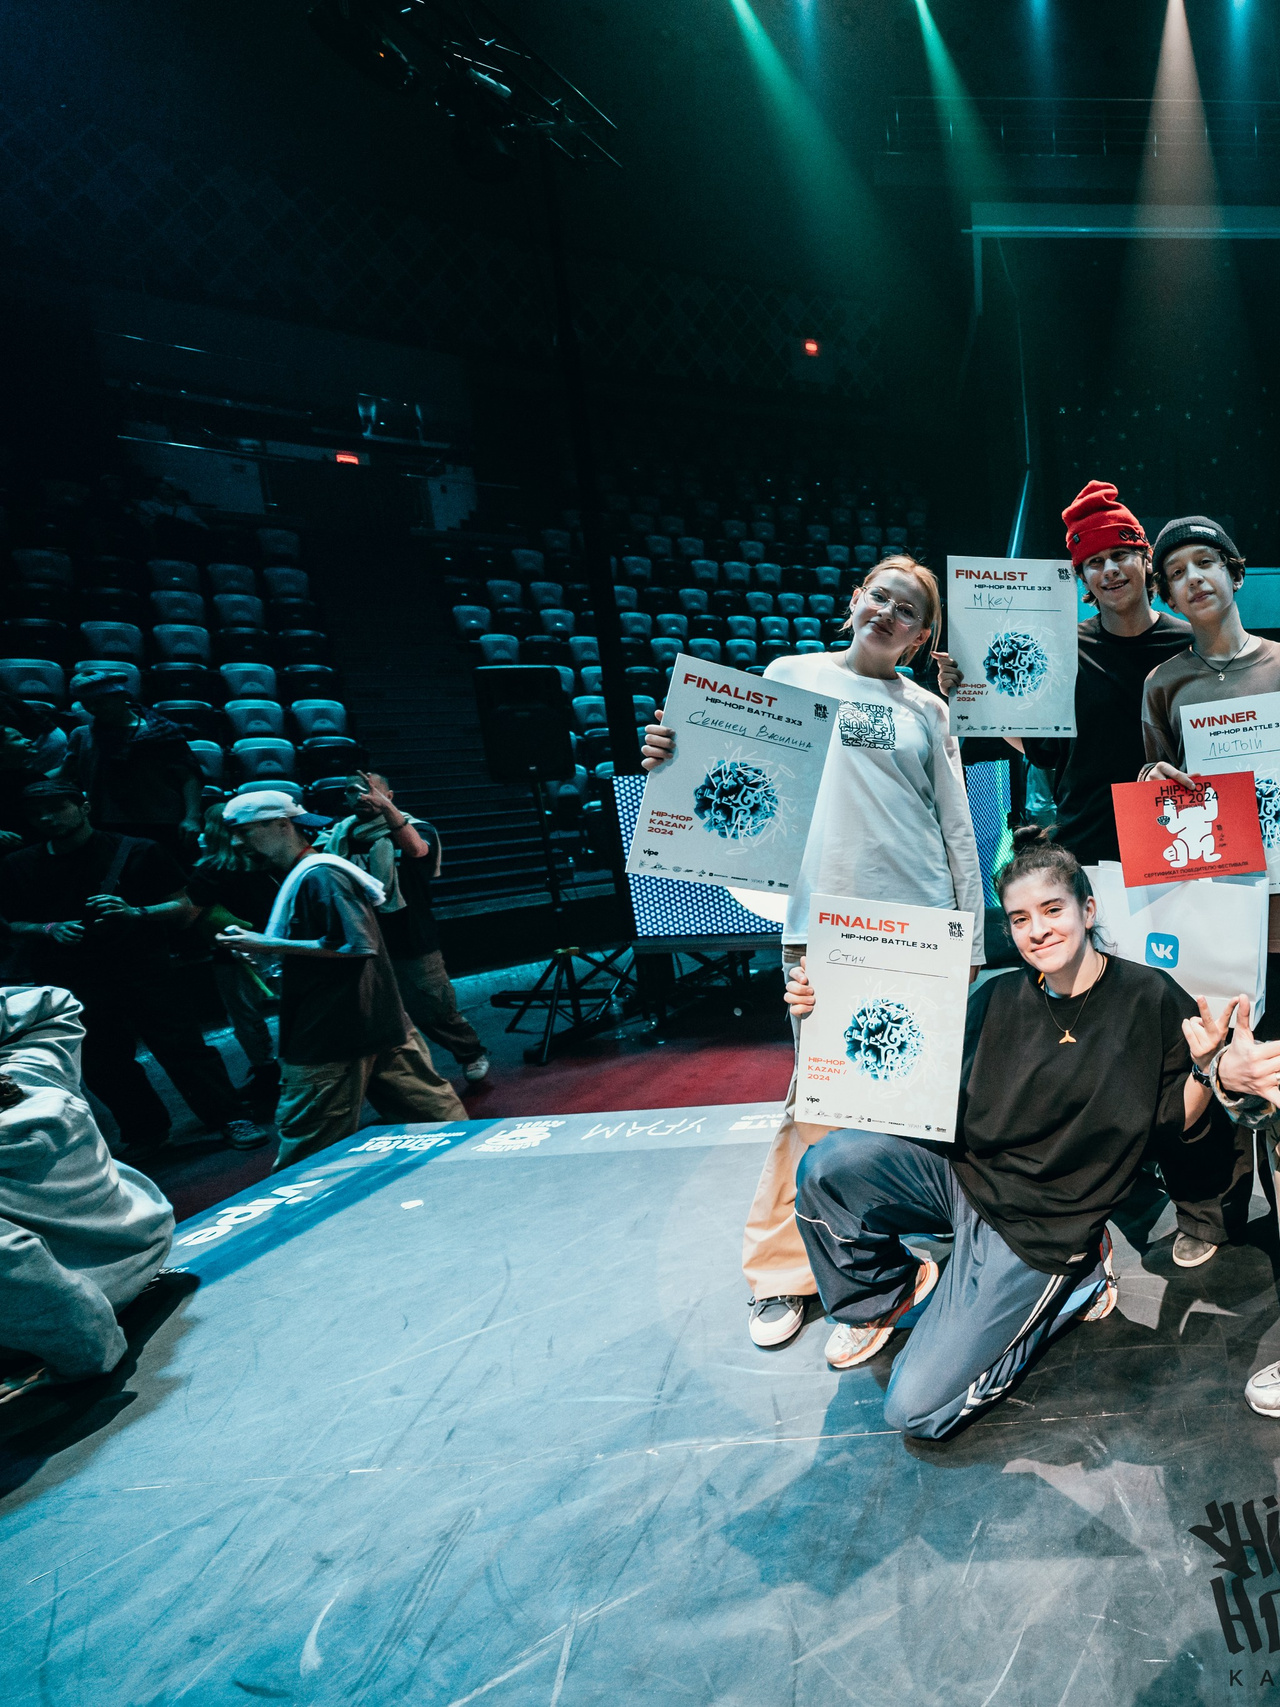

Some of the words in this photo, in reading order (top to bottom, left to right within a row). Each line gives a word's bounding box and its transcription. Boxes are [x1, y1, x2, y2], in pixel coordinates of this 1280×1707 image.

[955, 569, 1028, 581] FINALIST
[683, 673, 778, 708] FINALIST
[705, 696, 747, 712] HIP-HOP
[747, 707, 784, 722] BATTLE
[785, 717, 803, 727] 3X3
[1189, 710, 1258, 729] WINNER
[1209, 728, 1241, 737] HIP-HOP
[1242, 724, 1273, 733] BATTLE
[1155, 794, 1185, 807] FEST
[1188, 791, 1219, 804] 2024
[651, 810, 693, 822] HIP-HOP
[649, 818, 687, 830] KAZAN
[647, 826, 674, 836] 2024
[643, 848, 659, 857] vipe
[1144, 869, 1179, 879] СЕРТИФИКАТ
[818, 912, 910, 934] FINALIST
[841, 932, 879, 943] HIP-HOP
[881, 937, 918, 948] BATTLE
[919, 942, 938, 951] 3X3
[808, 1056, 846, 1066] HIP-HOP
[807, 1064, 841, 1075] KAZAN
[807, 1073, 830, 1082] 2024
[805, 1095, 821, 1104] vipe
[176, 1179, 324, 1246] vipe
